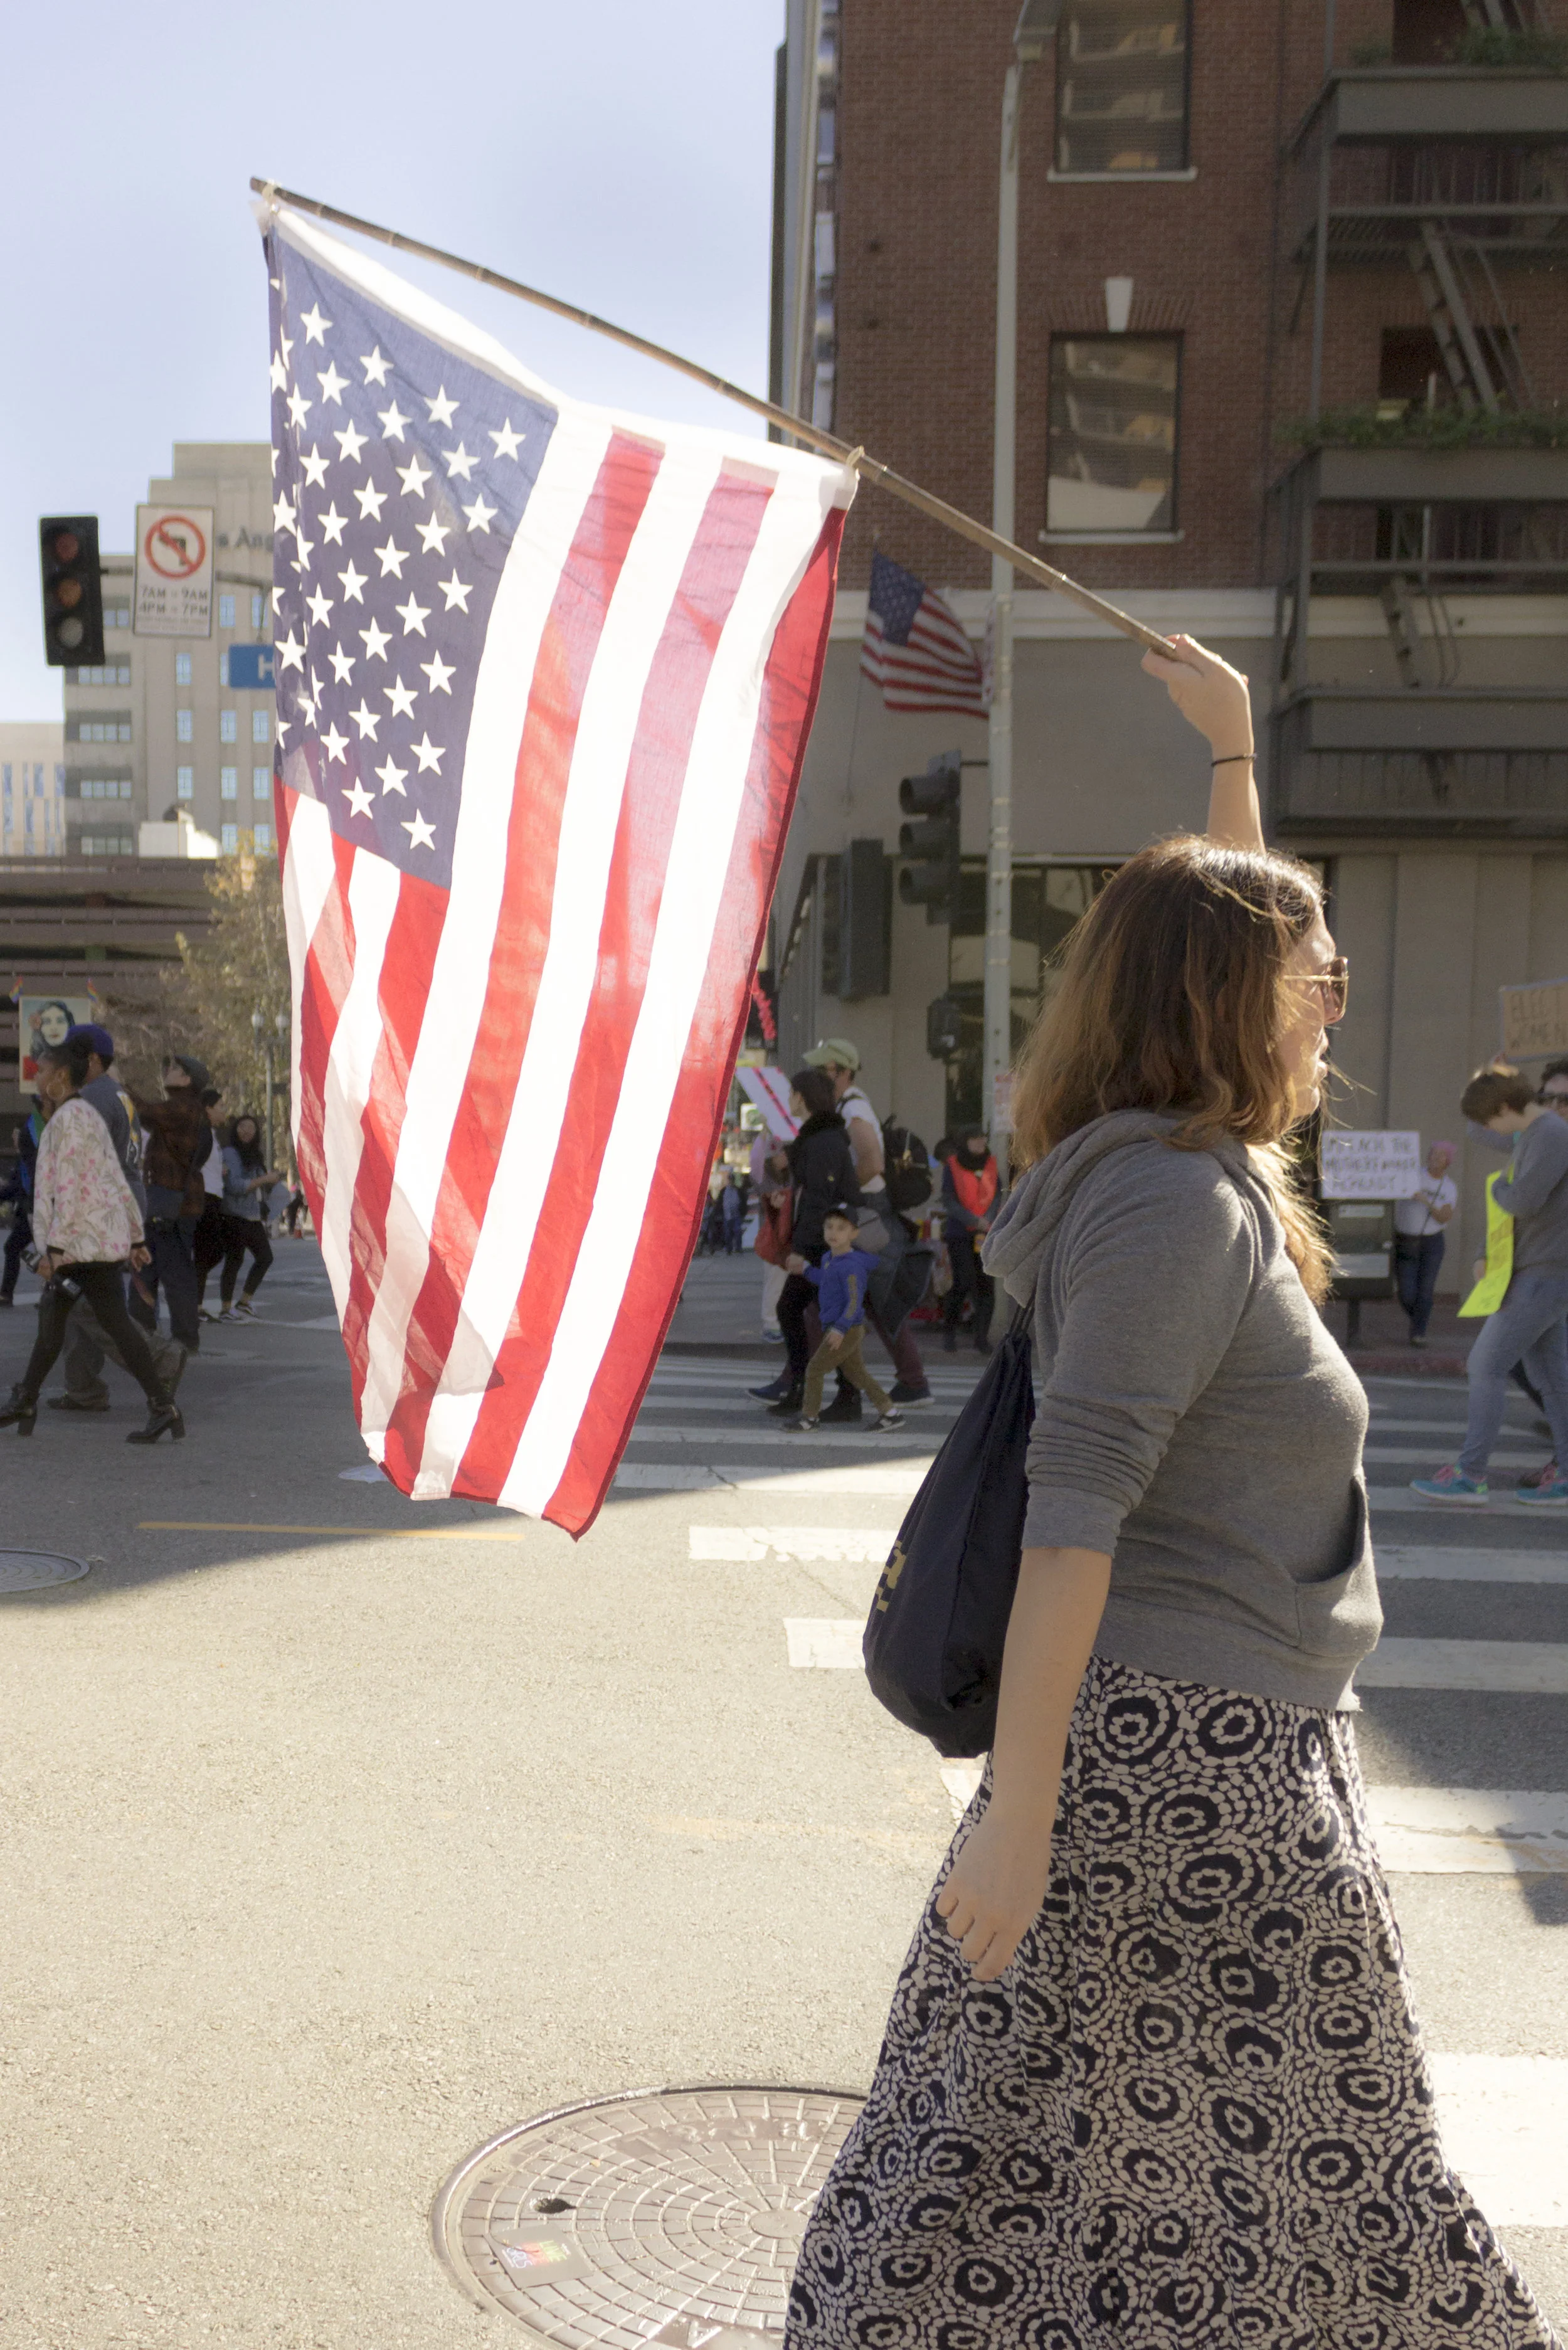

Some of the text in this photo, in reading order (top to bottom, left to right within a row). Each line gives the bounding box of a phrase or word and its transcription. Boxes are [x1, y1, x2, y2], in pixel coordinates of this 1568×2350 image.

[142, 585, 167, 598] 7AM
[182, 586, 208, 600] 9AM
[139, 601, 166, 613] 4PM
[182, 602, 208, 615] 7PM
